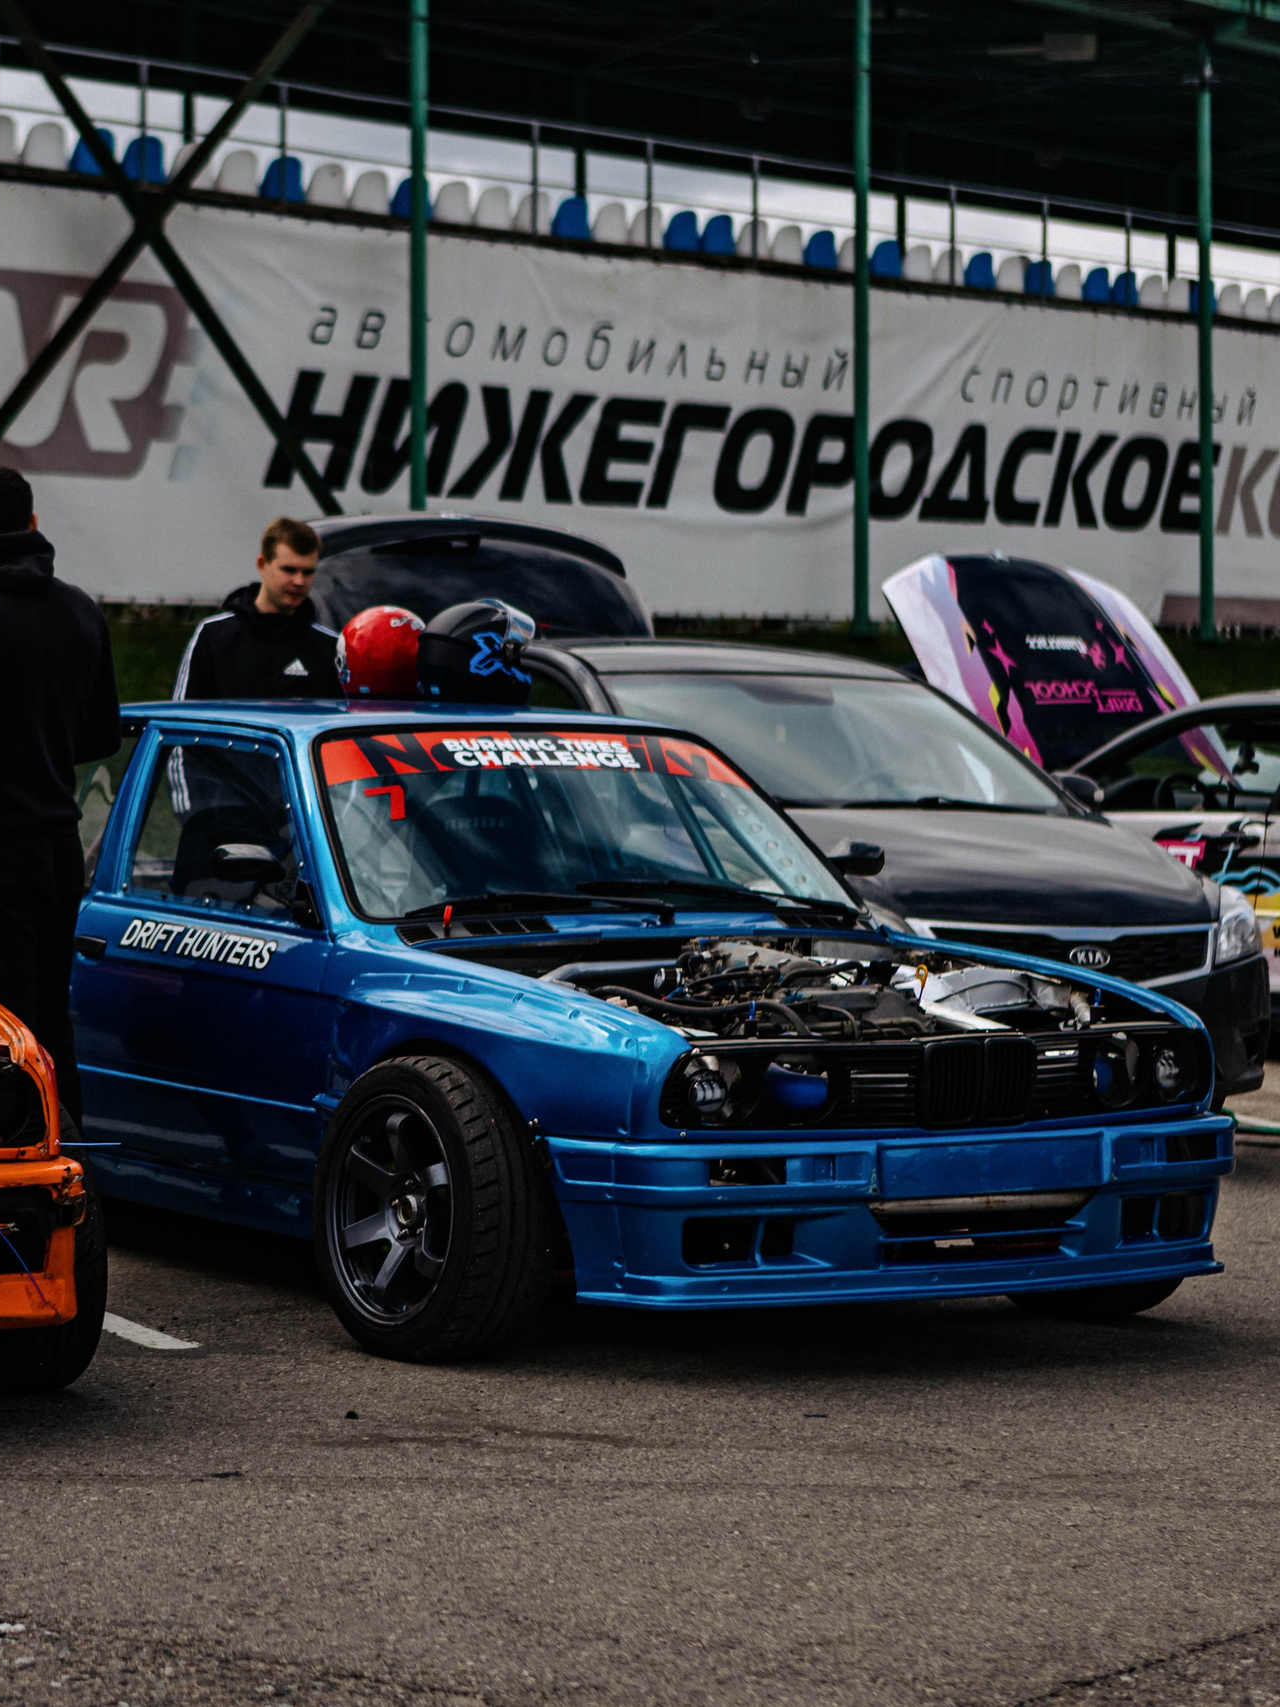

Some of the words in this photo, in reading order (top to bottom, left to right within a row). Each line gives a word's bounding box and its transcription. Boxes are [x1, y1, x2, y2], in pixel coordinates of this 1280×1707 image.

[309, 306, 850, 391] авомобильный
[1024, 680, 1098, 700] SCHOOL
[442, 737, 558, 755] BURNING
[558, 738, 629, 756] TIRES
[453, 749, 641, 770] CHALLENGE
[362, 784, 407, 822] 7
[120, 918, 186, 953] DRIFT
[175, 926, 278, 970] HUNTERS
[1076, 949, 1105, 965] KIA
